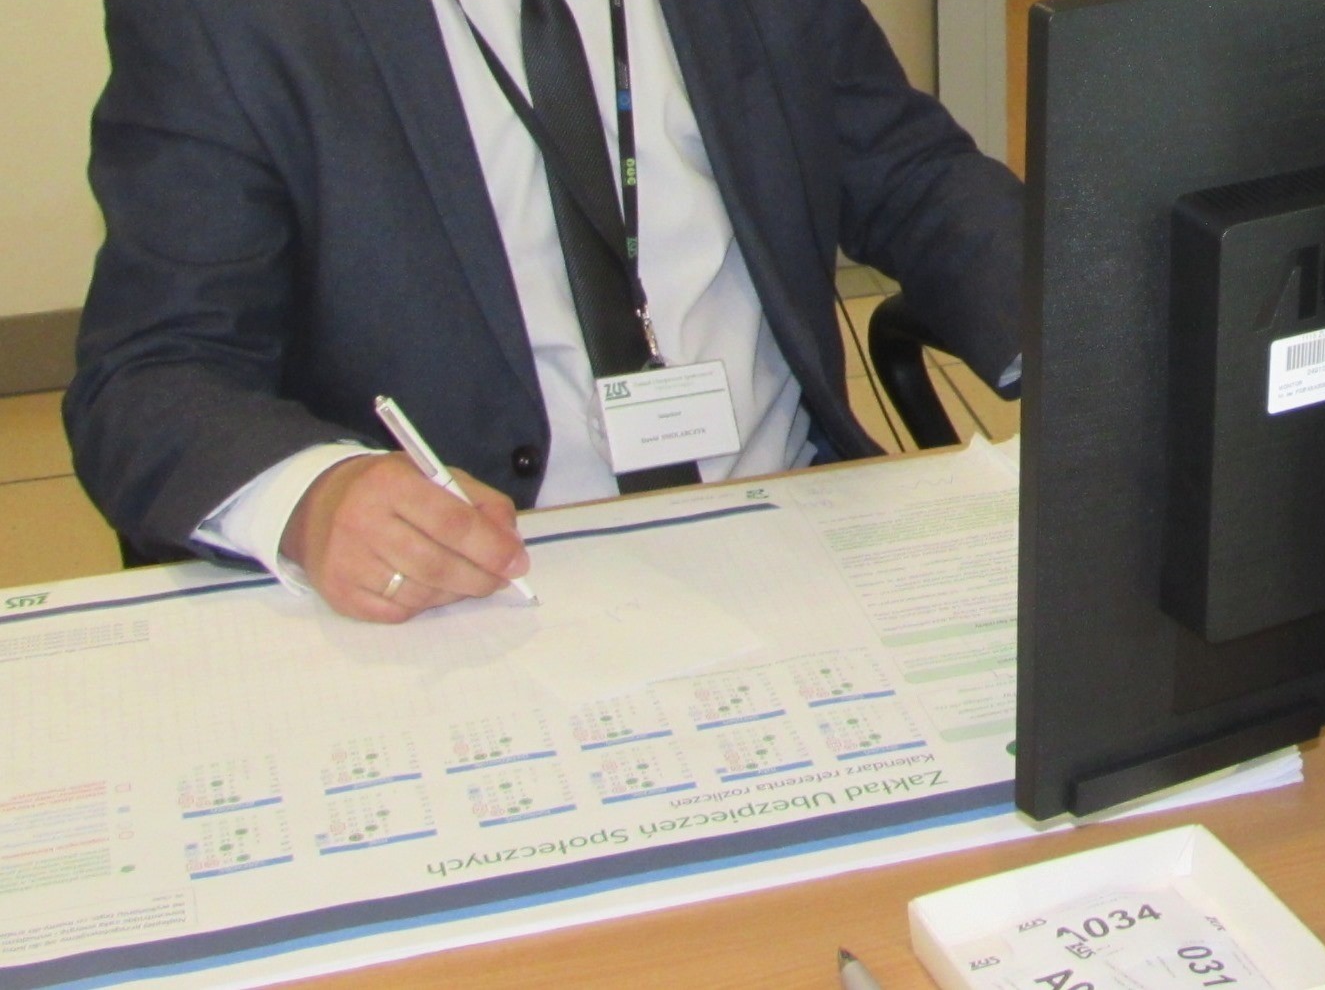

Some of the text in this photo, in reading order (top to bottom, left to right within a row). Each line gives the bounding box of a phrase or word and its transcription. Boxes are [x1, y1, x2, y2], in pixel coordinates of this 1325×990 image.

[603, 381, 632, 401] ZUS
[5, 592, 51, 609] ZUS
[669, 752, 936, 809] Kalendarz referenta rozliczeń
[426, 770, 948, 877] Zakład Ubezpieczeń Społecznych
